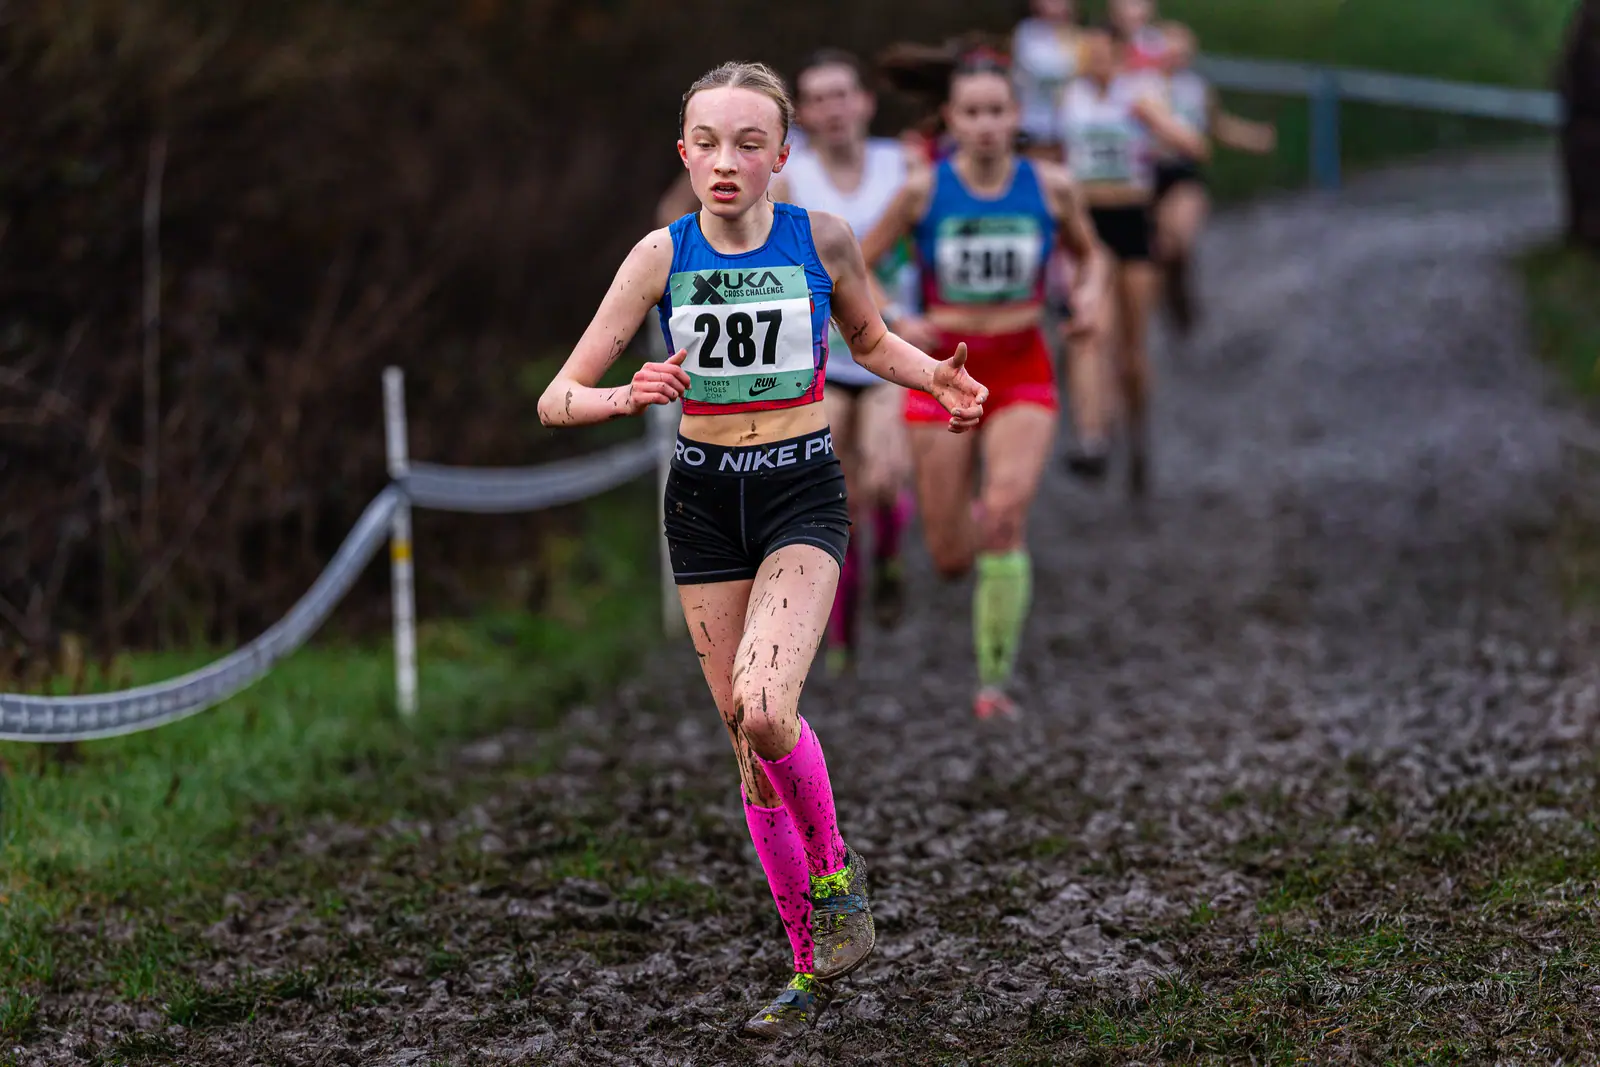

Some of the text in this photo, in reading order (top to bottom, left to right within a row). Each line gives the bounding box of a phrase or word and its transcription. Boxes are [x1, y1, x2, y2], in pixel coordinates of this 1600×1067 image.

[723, 271, 783, 289] UKA
[724, 286, 785, 298] CROSS CHALLENGE
[694, 309, 783, 368] 287
[754, 377, 777, 388] RUN
[718, 443, 798, 472] NIKE
